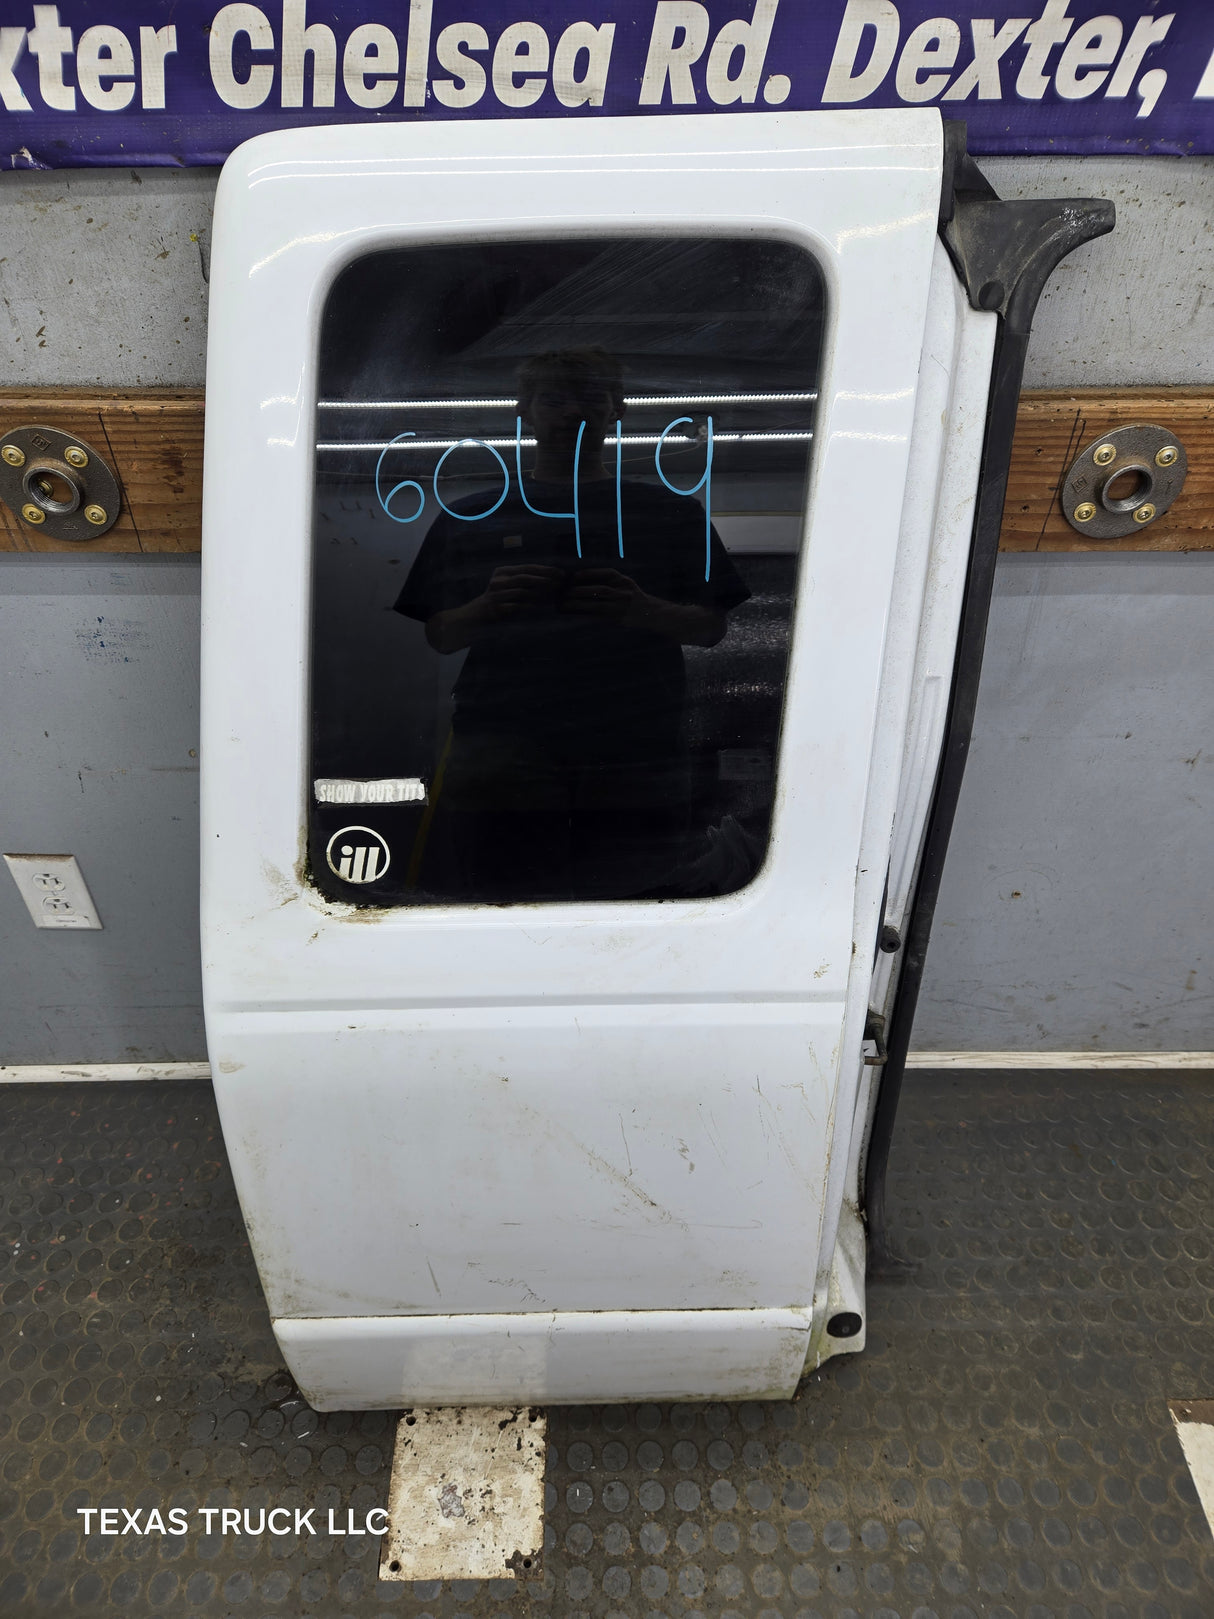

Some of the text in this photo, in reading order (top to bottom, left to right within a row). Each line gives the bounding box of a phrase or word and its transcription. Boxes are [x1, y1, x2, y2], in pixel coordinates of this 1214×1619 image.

[209, 0, 617, 109] Chelsea
[638, 0, 791, 105] Rd.
[820, 0, 1176, 119] Dexter,
[376, 416, 714, 582] 60419
[319, 783, 356, 803] SHOW
[360, 783, 395, 803] YOUR
